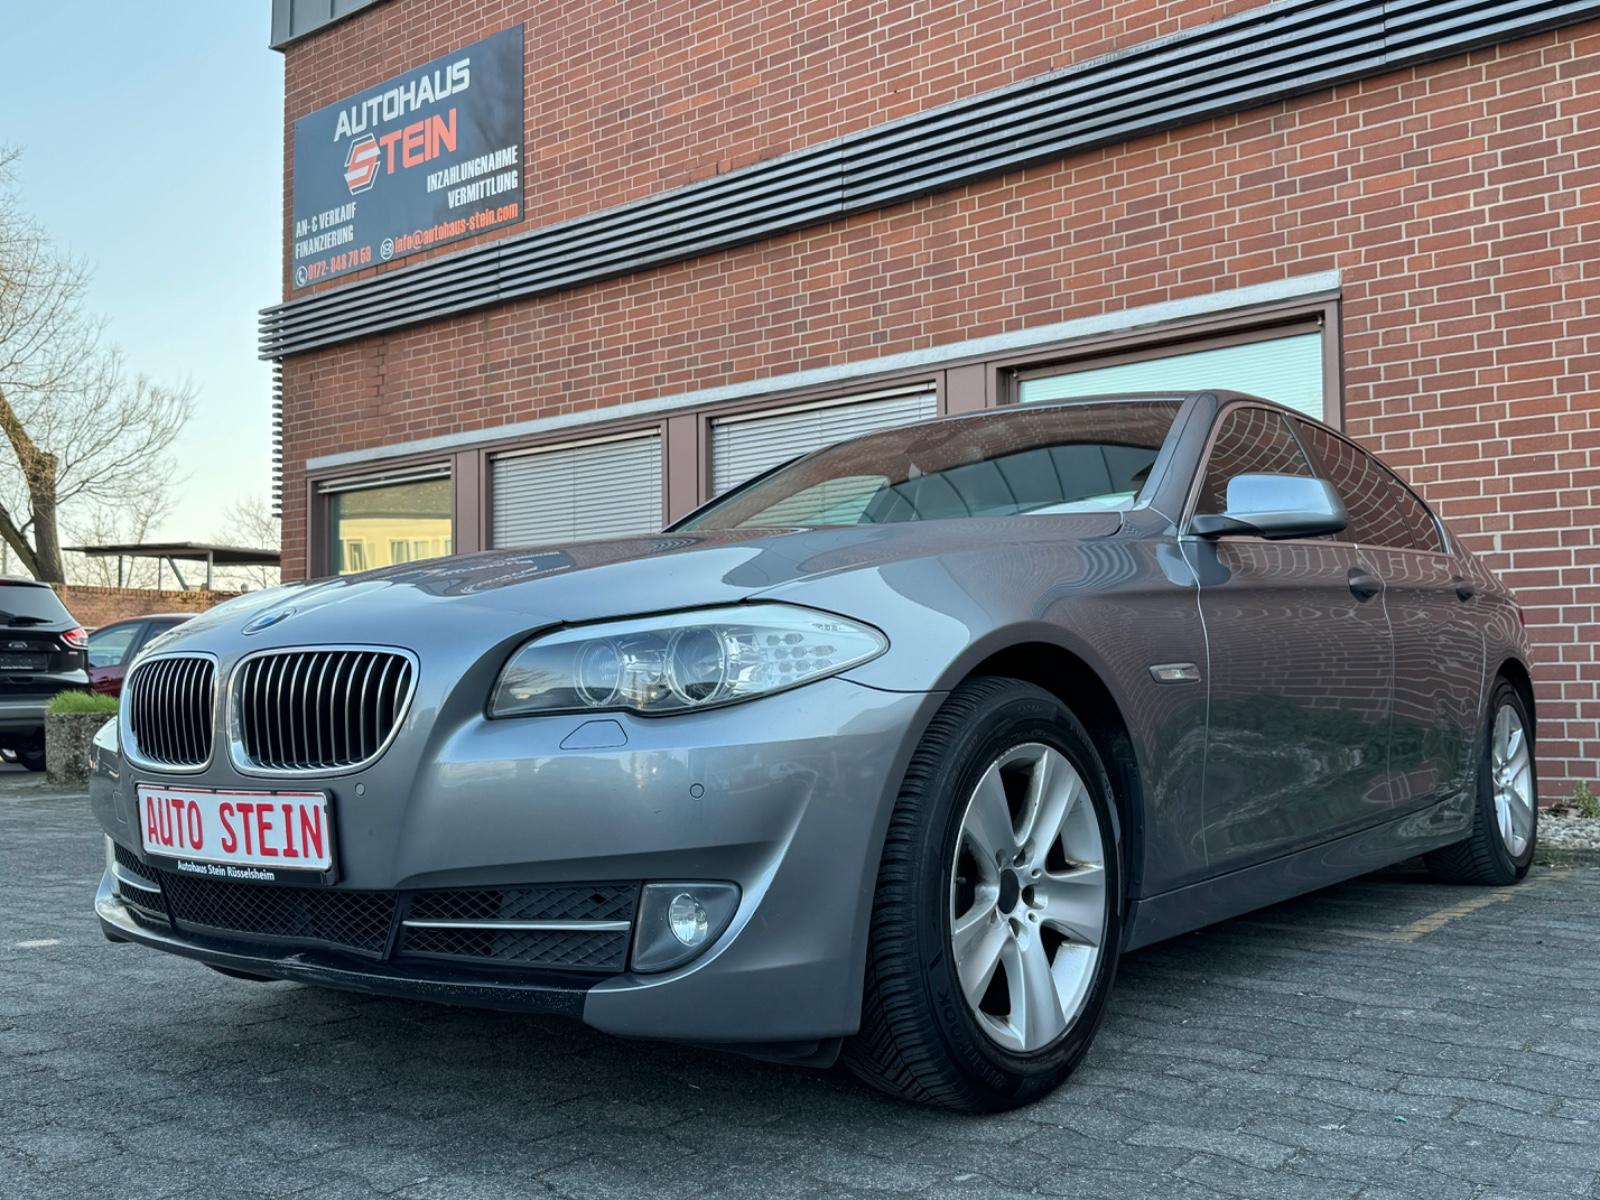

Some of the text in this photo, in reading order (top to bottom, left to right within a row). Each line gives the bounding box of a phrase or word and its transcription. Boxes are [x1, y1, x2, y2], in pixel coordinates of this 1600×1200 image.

[333, 58, 471, 142] AUTOHAUS
[344, 108, 457, 195] STEIN
[427, 145, 518, 193] INZAHLUNGNAHME
[448, 170, 518, 209] VERMITTLUNG
[318, 201, 357, 230] VERKAUF
[394, 203, 518, 253] info@autohaus-stein.com
[295, 225, 354, 259] FINANZIERUNG
[146, 796, 323, 859] AUTO STEIN
[177, 861, 275, 881] Autohaus Stein Rüsselsheim
